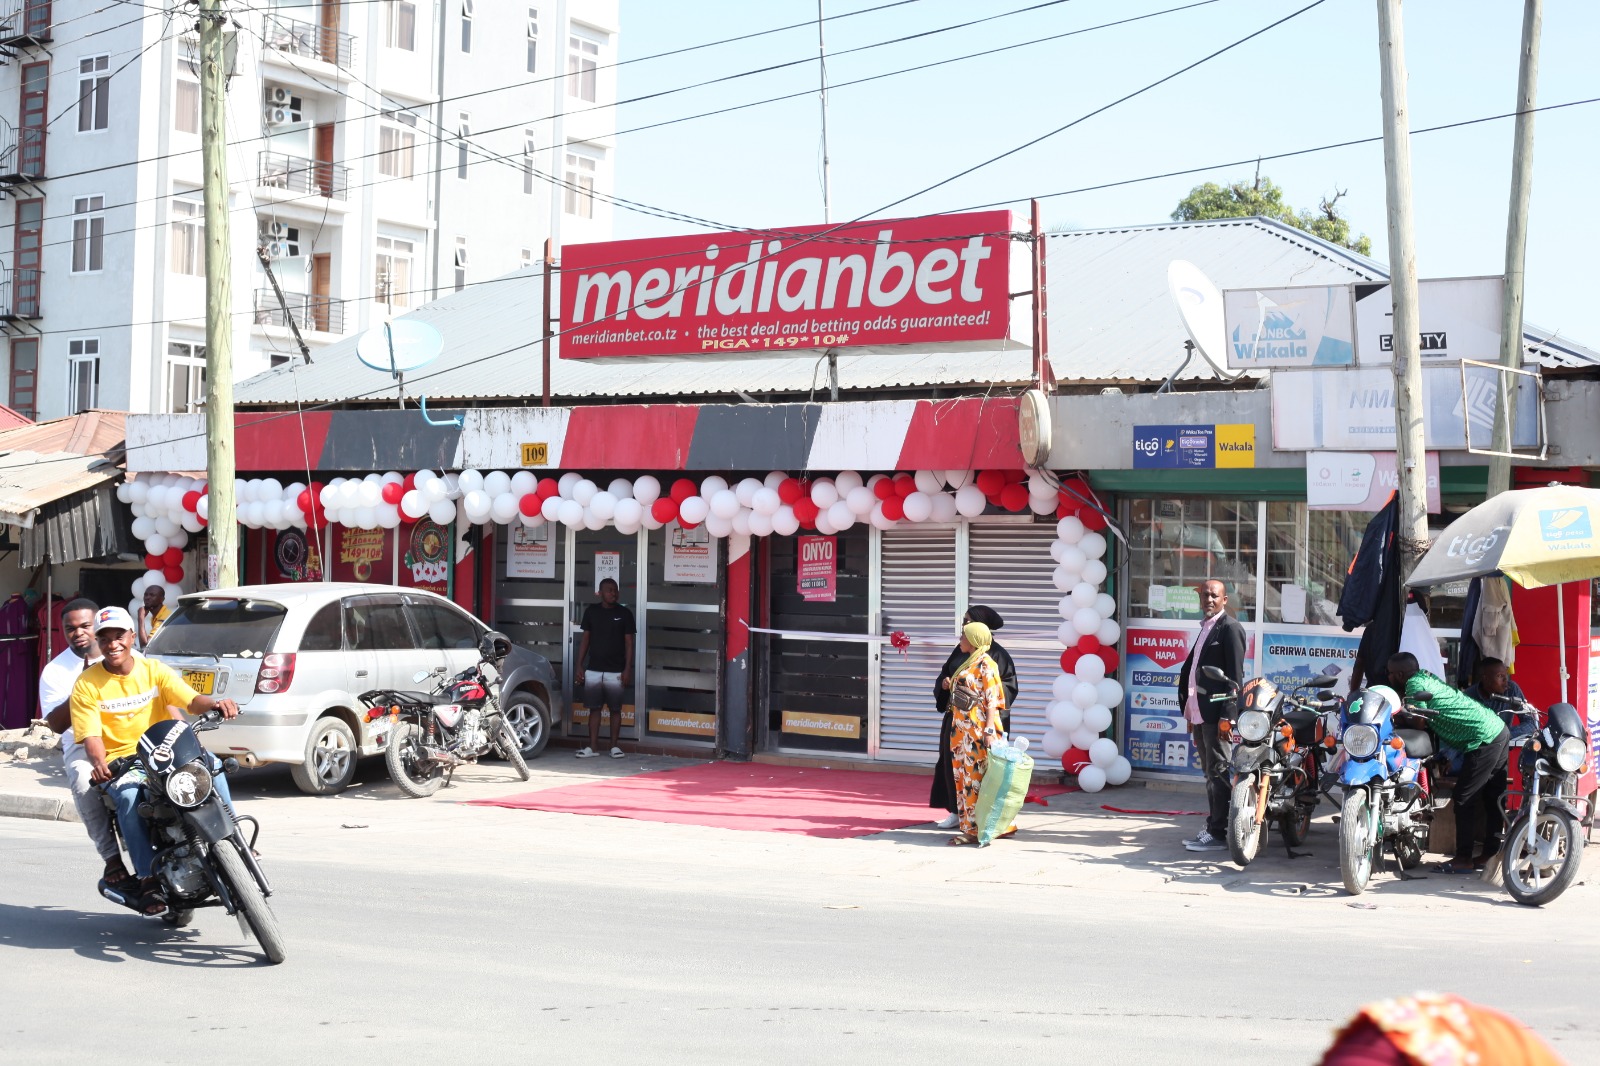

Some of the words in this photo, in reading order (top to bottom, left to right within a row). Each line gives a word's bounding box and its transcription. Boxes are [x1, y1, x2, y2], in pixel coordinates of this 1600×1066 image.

[572, 230, 992, 324] meridianbet
[572, 328, 677, 344] meridianbet.co.tz
[698, 325, 717, 338] the
[720, 323, 748, 337] best
[751, 321, 779, 336] deal
[782, 319, 808, 334] and
[811, 317, 860, 335] betting
[863, 315, 897, 331] odds
[900, 310, 991, 332] guaranteed!
[1234, 342, 1308, 360] Wakala
[1219, 441, 1253, 451] Wakala
[526, 446, 545, 462] 109
[803, 541, 833, 562] ONYO
[1548, 541, 1592, 551] Wakala
[1133, 637, 1157, 647] LIPIA
[1160, 638, 1185, 648] HAPA
[1155, 651, 1176, 660] HAPA
[1269, 645, 1307, 656] GERIRWA
[1309, 648, 1347, 658] GENERAL
[1152, 675, 1172, 684] pesa
[1149, 697, 1180, 707] StarTime
[657, 717, 716, 729] meridianbet.co.t
[785, 718, 855, 732] meridianbet.co.tz
[1132, 741, 1160, 749] PASSPORT
[1131, 748, 1160, 762] SIZE
